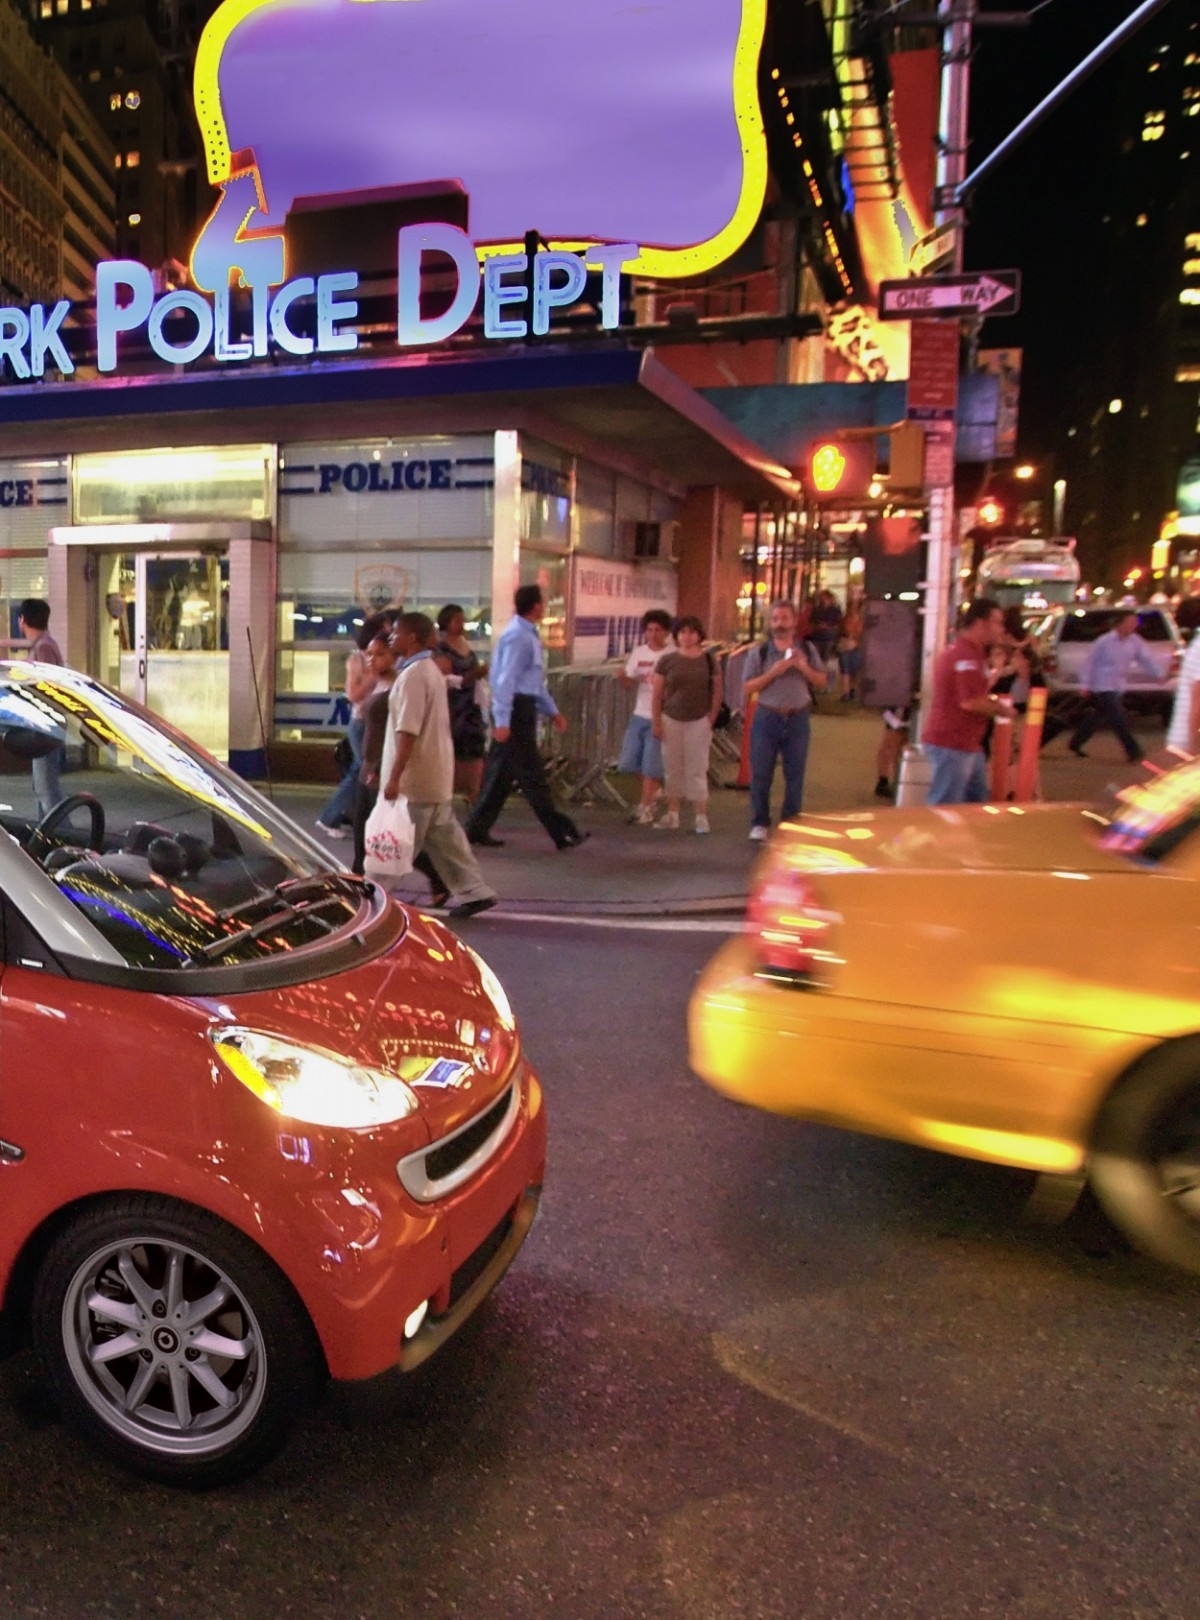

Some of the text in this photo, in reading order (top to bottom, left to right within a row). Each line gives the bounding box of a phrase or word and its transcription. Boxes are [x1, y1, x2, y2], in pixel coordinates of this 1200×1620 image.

[96, 260, 358, 372] POLICE
[398, 222, 639, 345] DEPT
[895, 283, 1000, 308] ONE WAY
[319, 457, 453, 494] POLICE
